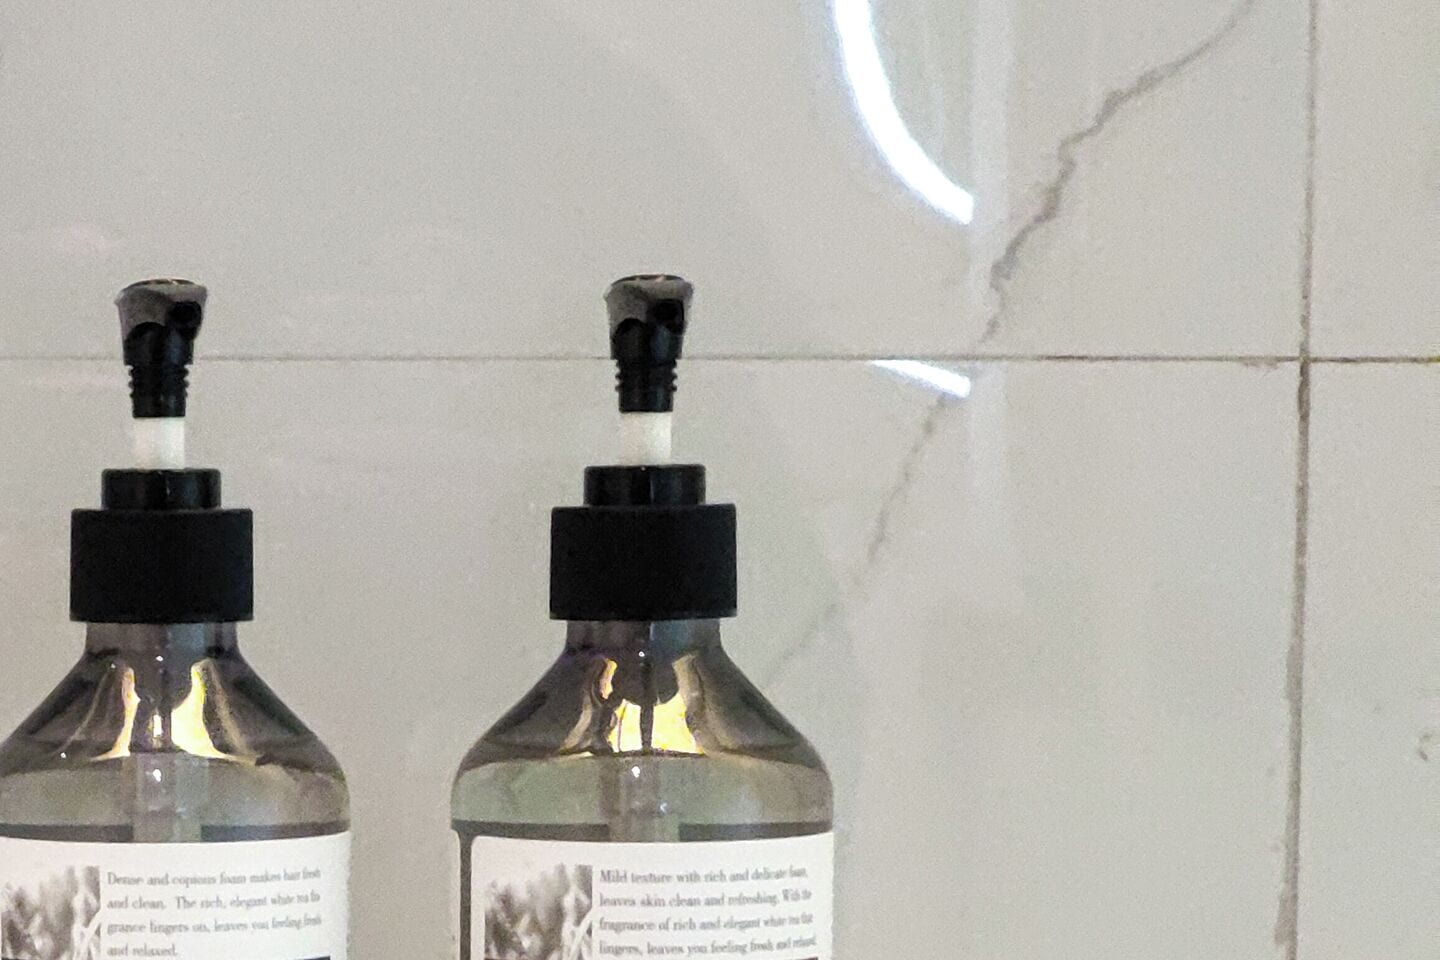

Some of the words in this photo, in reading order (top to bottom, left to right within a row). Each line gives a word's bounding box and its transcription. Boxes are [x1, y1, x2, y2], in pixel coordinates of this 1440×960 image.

[147, 872, 169, 886] and
[599, 869, 627, 883] Mild
[631, 872, 673, 883] texture
[675, 870, 701, 883] with
[704, 869, 727, 883] rich
[729, 867, 749, 882] and
[107, 895, 129, 909] and
[175, 895, 196, 910] The
[599, 892, 636, 907] leaves
[640, 893, 666, 907] skin
[668, 892, 701, 907] clean
[704, 892, 724, 906] and
[599, 916, 656, 935] fragrance
[658, 916, 671, 931] of
[673, 917, 697, 931] rich
[699, 916, 720, 930] and
[107, 943, 129, 957] and
[646, 941, 684, 955] leaves
[687, 945, 708, 958] you
